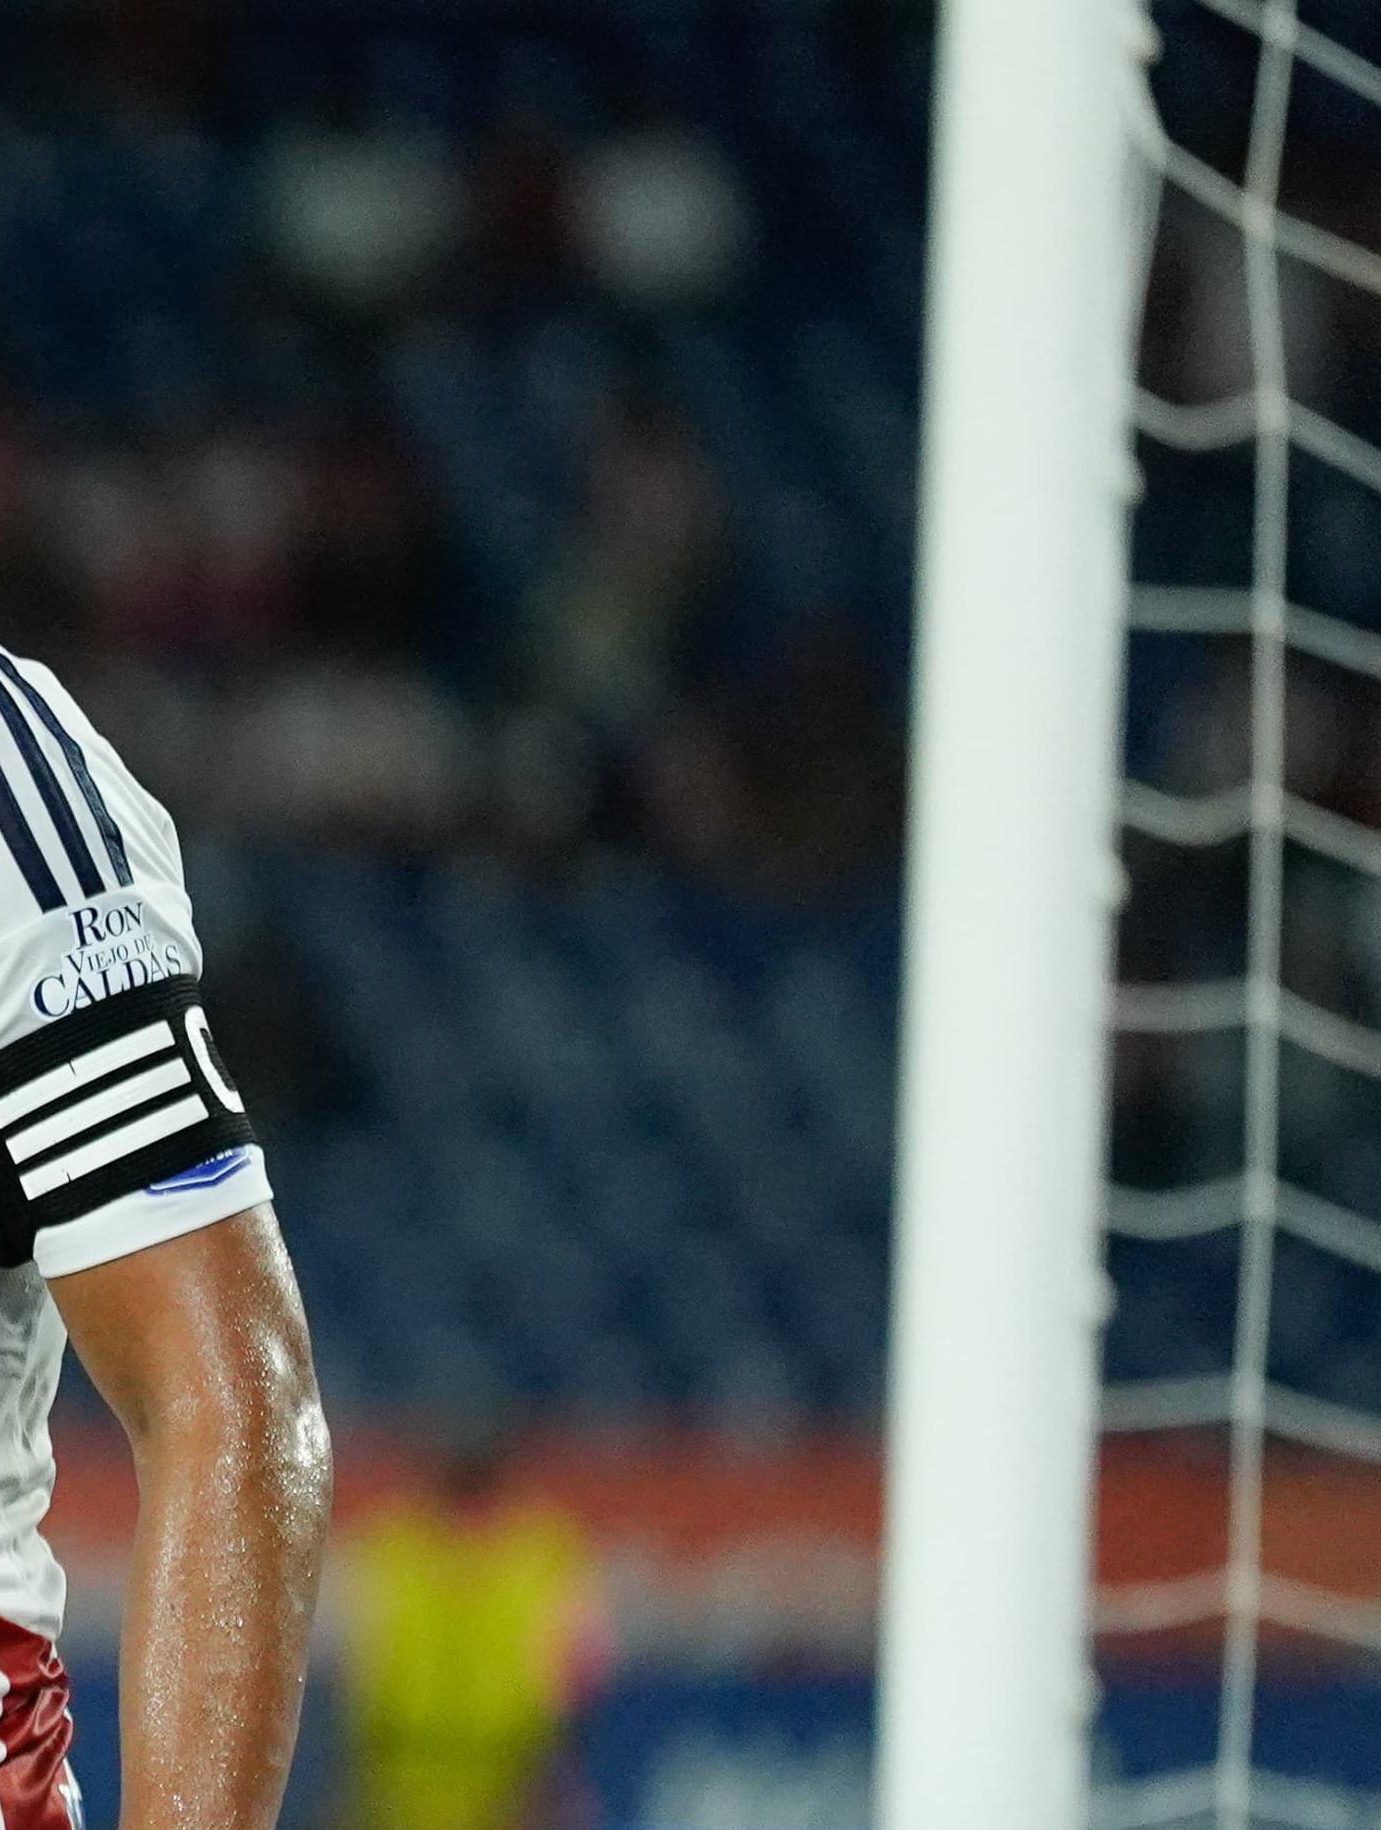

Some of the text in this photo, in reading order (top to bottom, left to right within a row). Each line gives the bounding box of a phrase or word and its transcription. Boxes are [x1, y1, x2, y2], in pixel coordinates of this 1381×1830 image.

[71, 902, 143, 949] RON
[66, 934, 155, 976] VIEJO DE
[34, 944, 182, 1017] CALDAS
